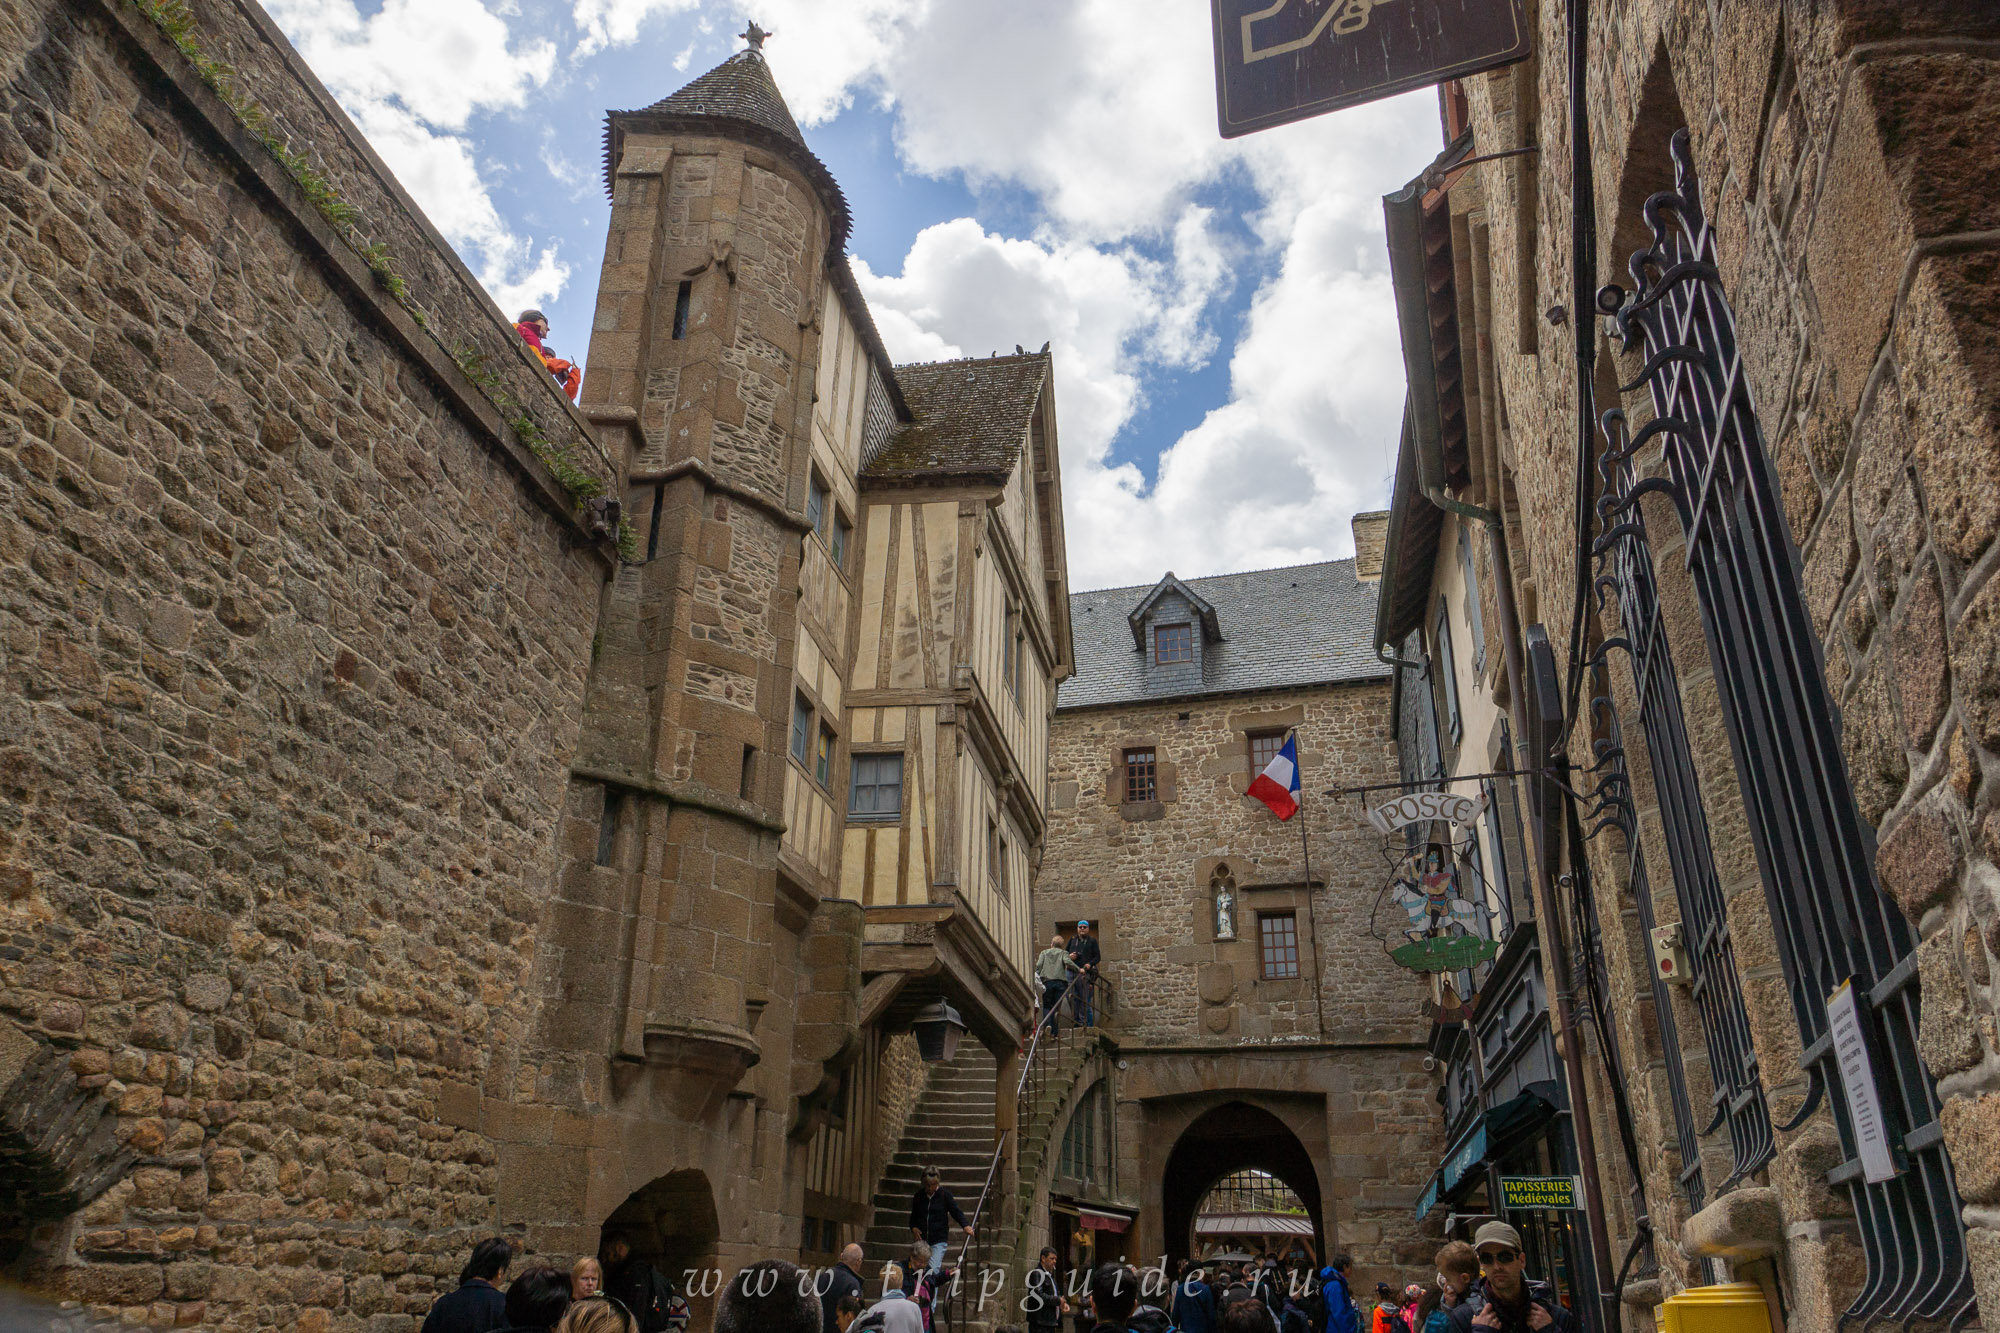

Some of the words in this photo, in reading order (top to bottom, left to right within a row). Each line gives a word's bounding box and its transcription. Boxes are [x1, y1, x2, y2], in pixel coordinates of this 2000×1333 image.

[1378, 794, 1474, 829] POSTE
[1503, 1181, 1572, 1192] TAPISSERIES
[1509, 1192, 1571, 1204] Médiévales
